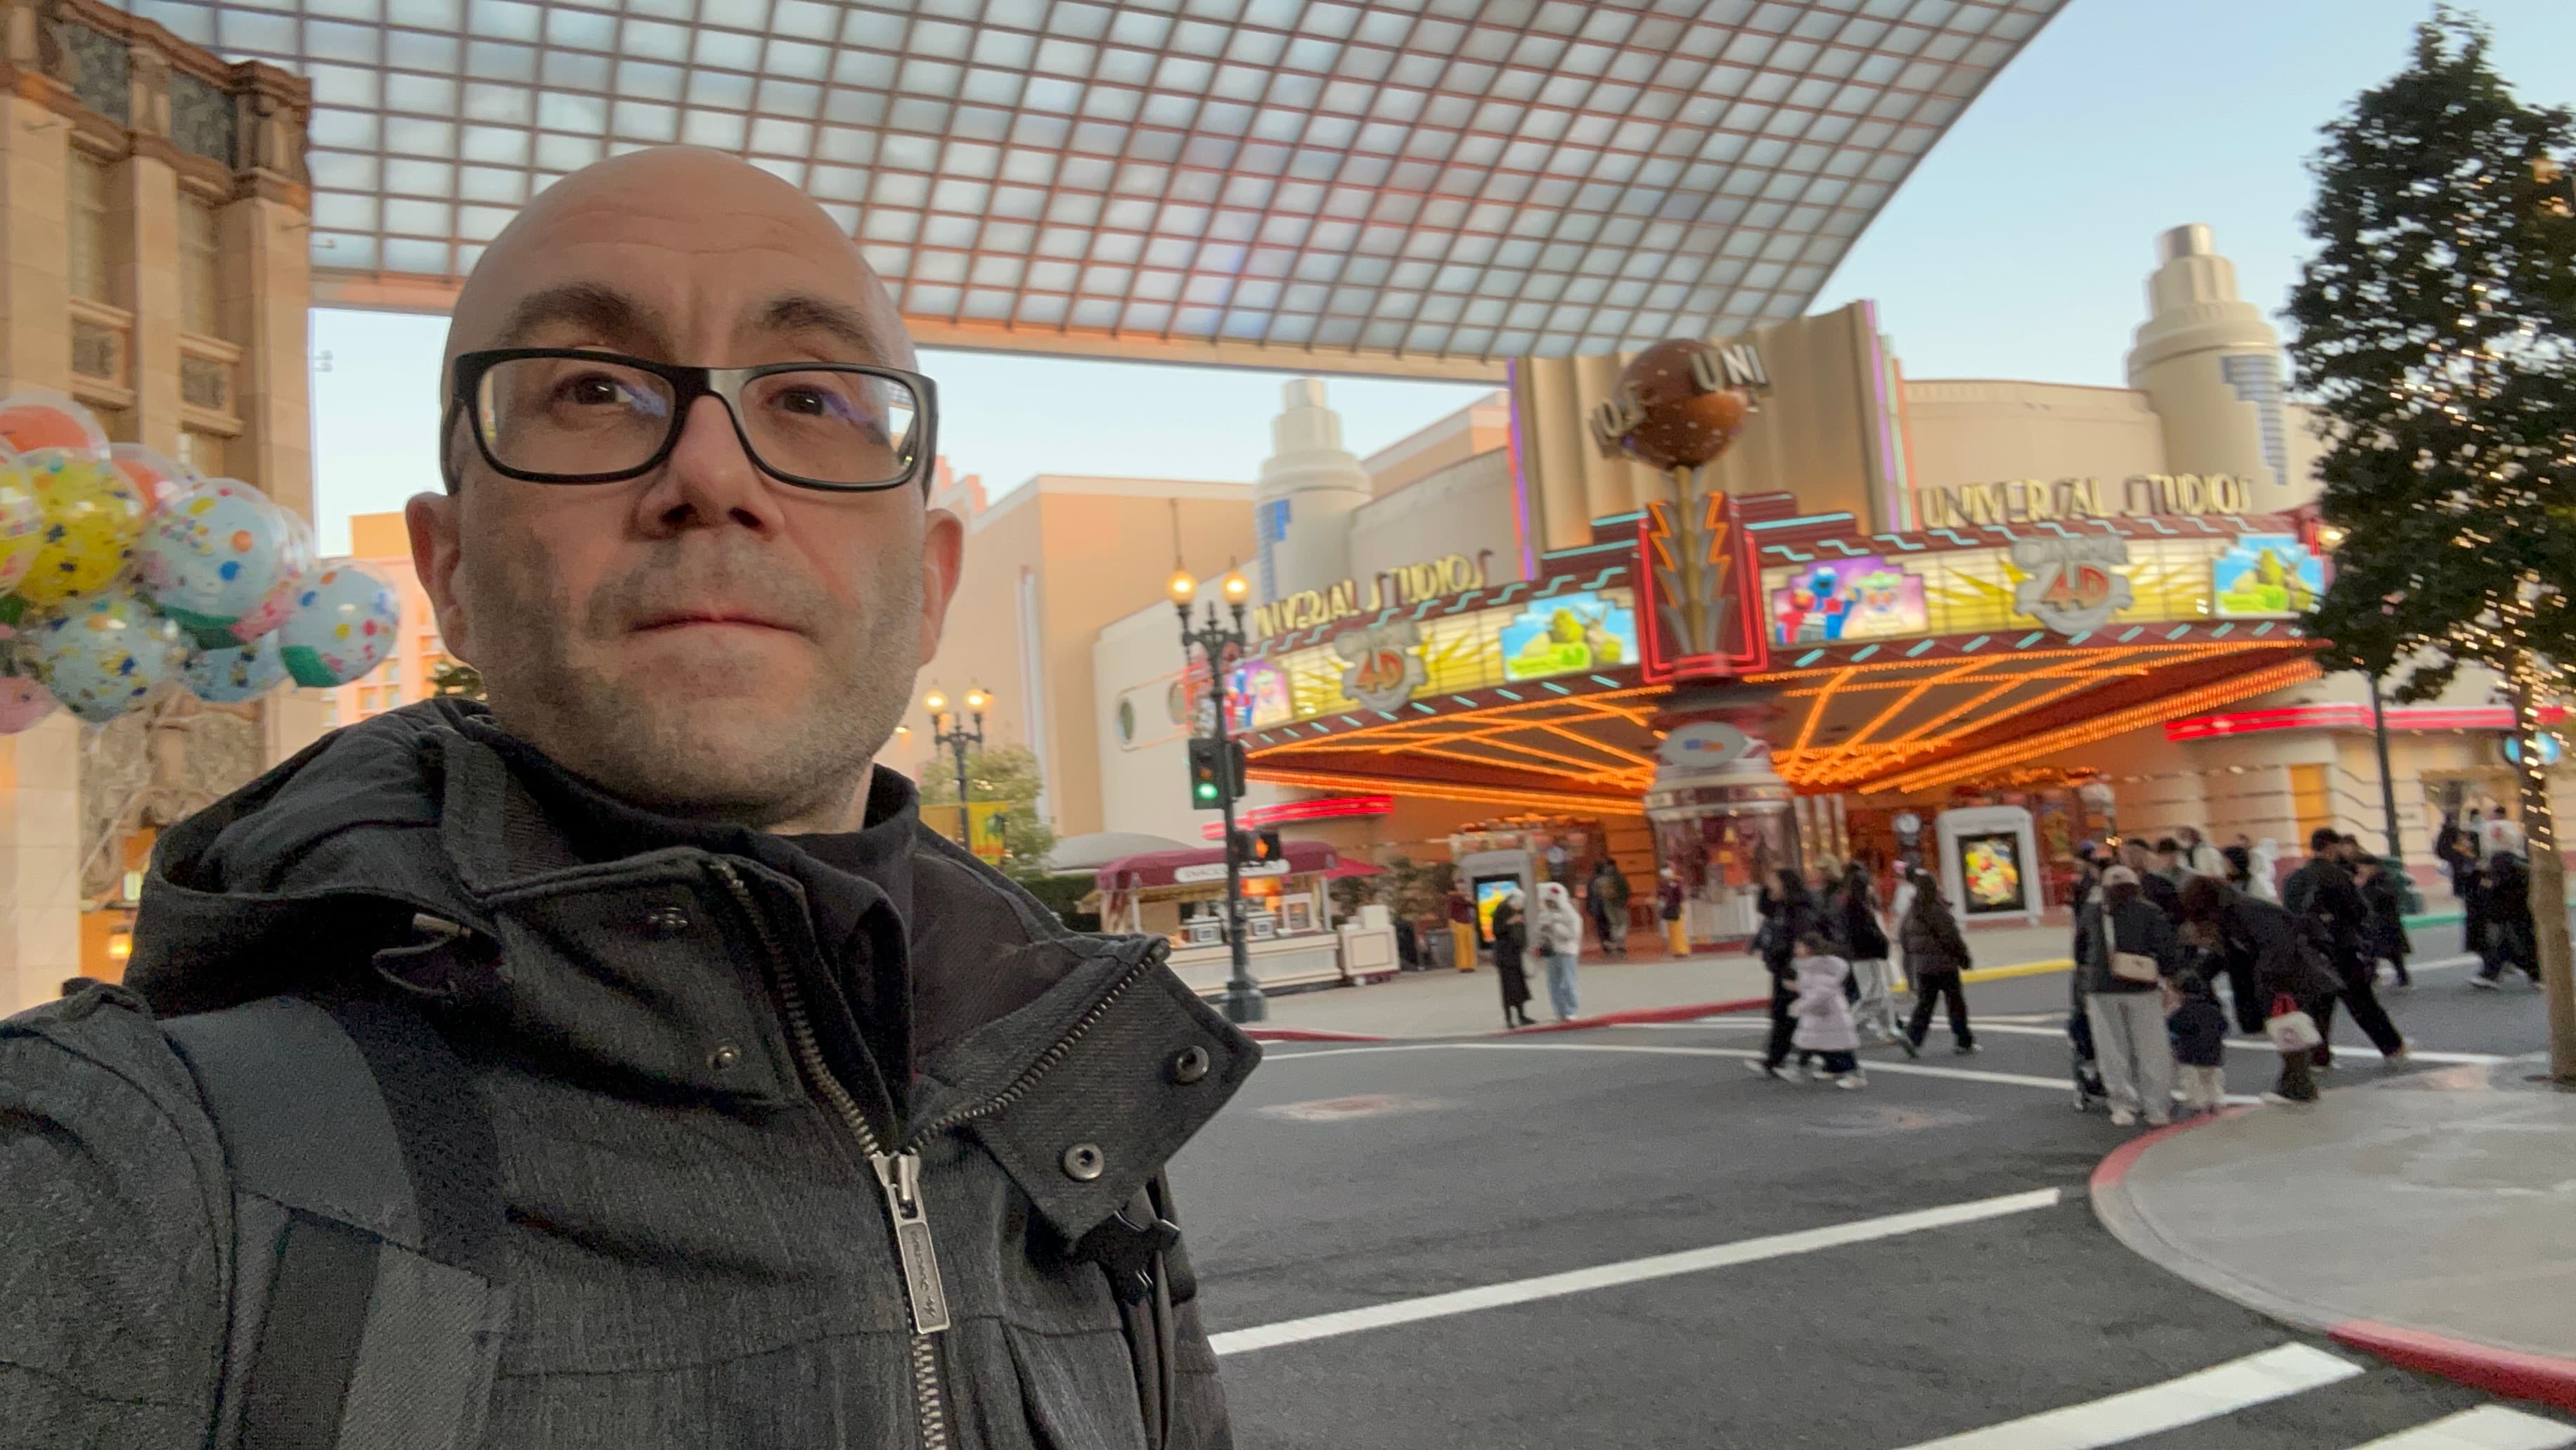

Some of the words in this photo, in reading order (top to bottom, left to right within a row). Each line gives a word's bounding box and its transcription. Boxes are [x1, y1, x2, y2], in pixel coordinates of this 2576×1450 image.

[1919, 477, 2114, 527] UNIVERSAL
[2120, 473, 2253, 517] STUDIOS
[1366, 548, 1493, 611] STUDIOS
